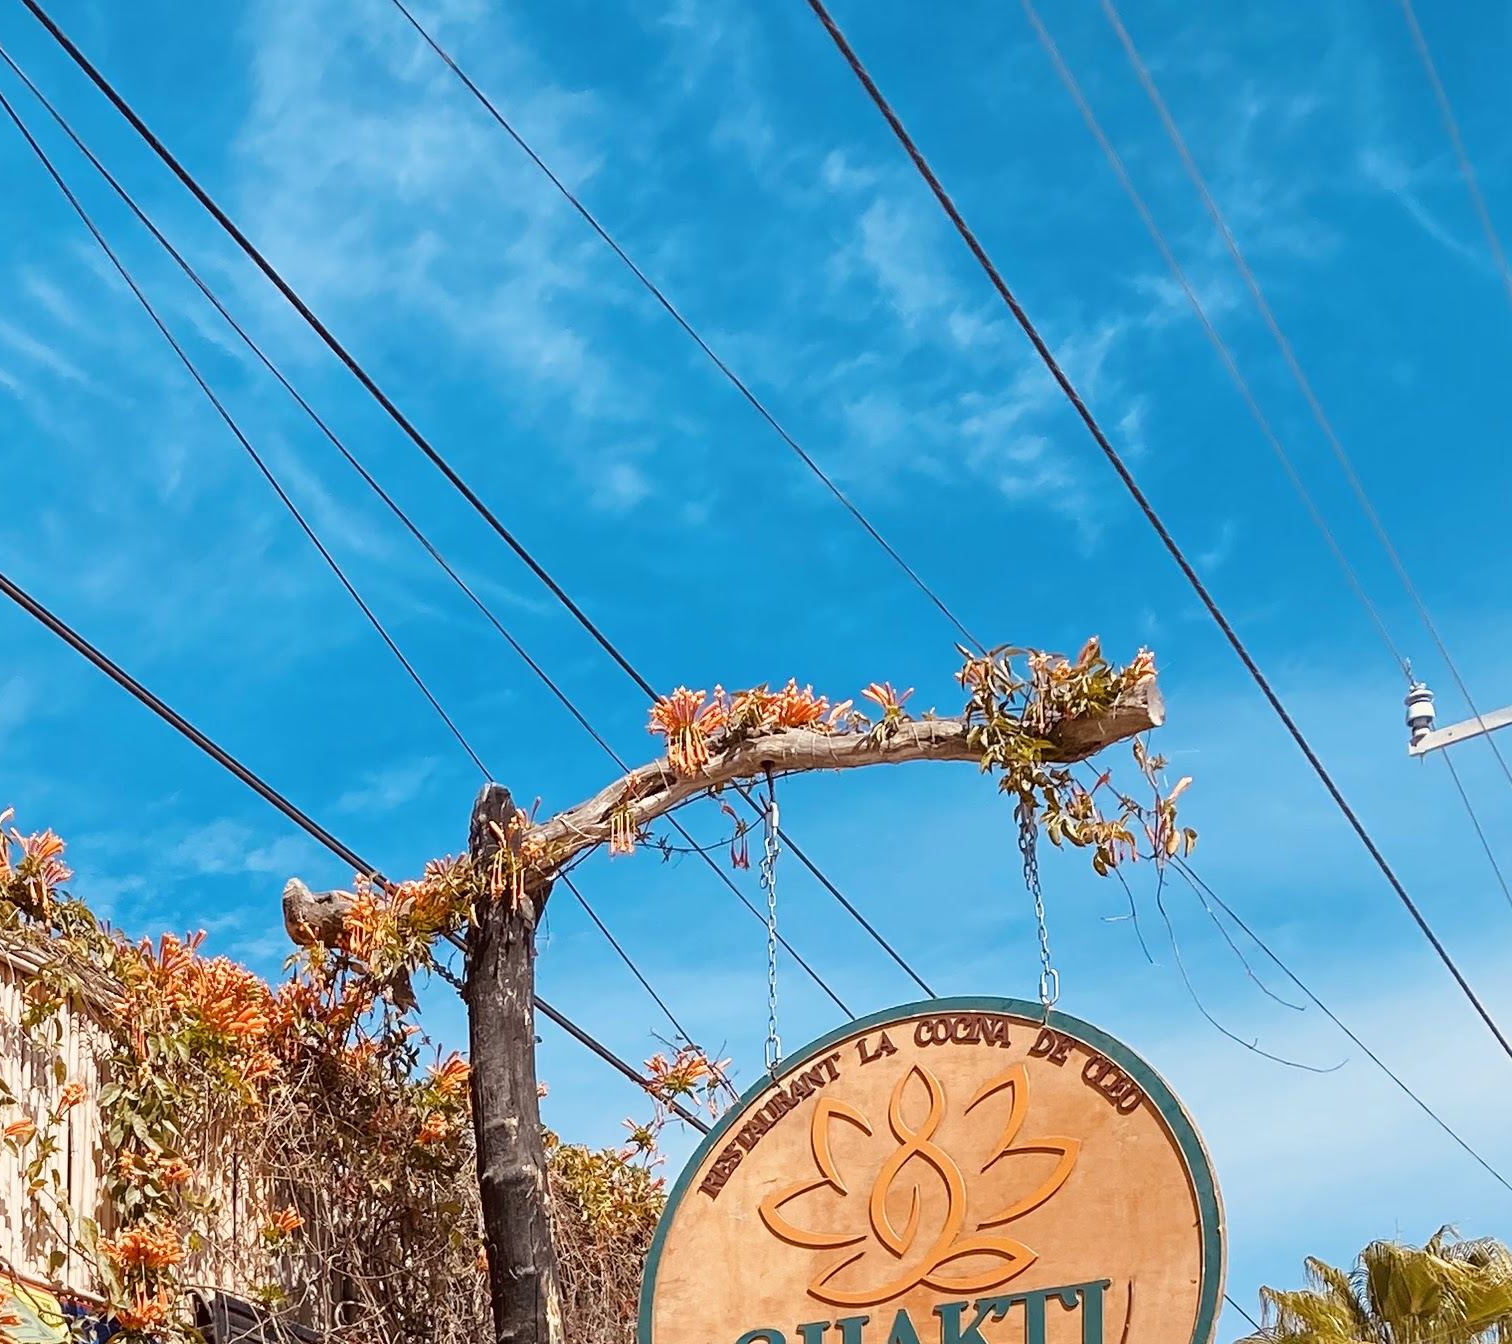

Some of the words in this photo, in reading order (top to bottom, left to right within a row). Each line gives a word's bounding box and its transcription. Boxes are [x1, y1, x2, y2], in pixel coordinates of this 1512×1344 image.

[697, 1051, 841, 1201] RESTAURANT
[855, 1031, 898, 1066] LA
[914, 1015, 1011, 1048] COCINA
[1027, 1028, 1075, 1067] DE
[1081, 1053, 1144, 1115] CLEO
